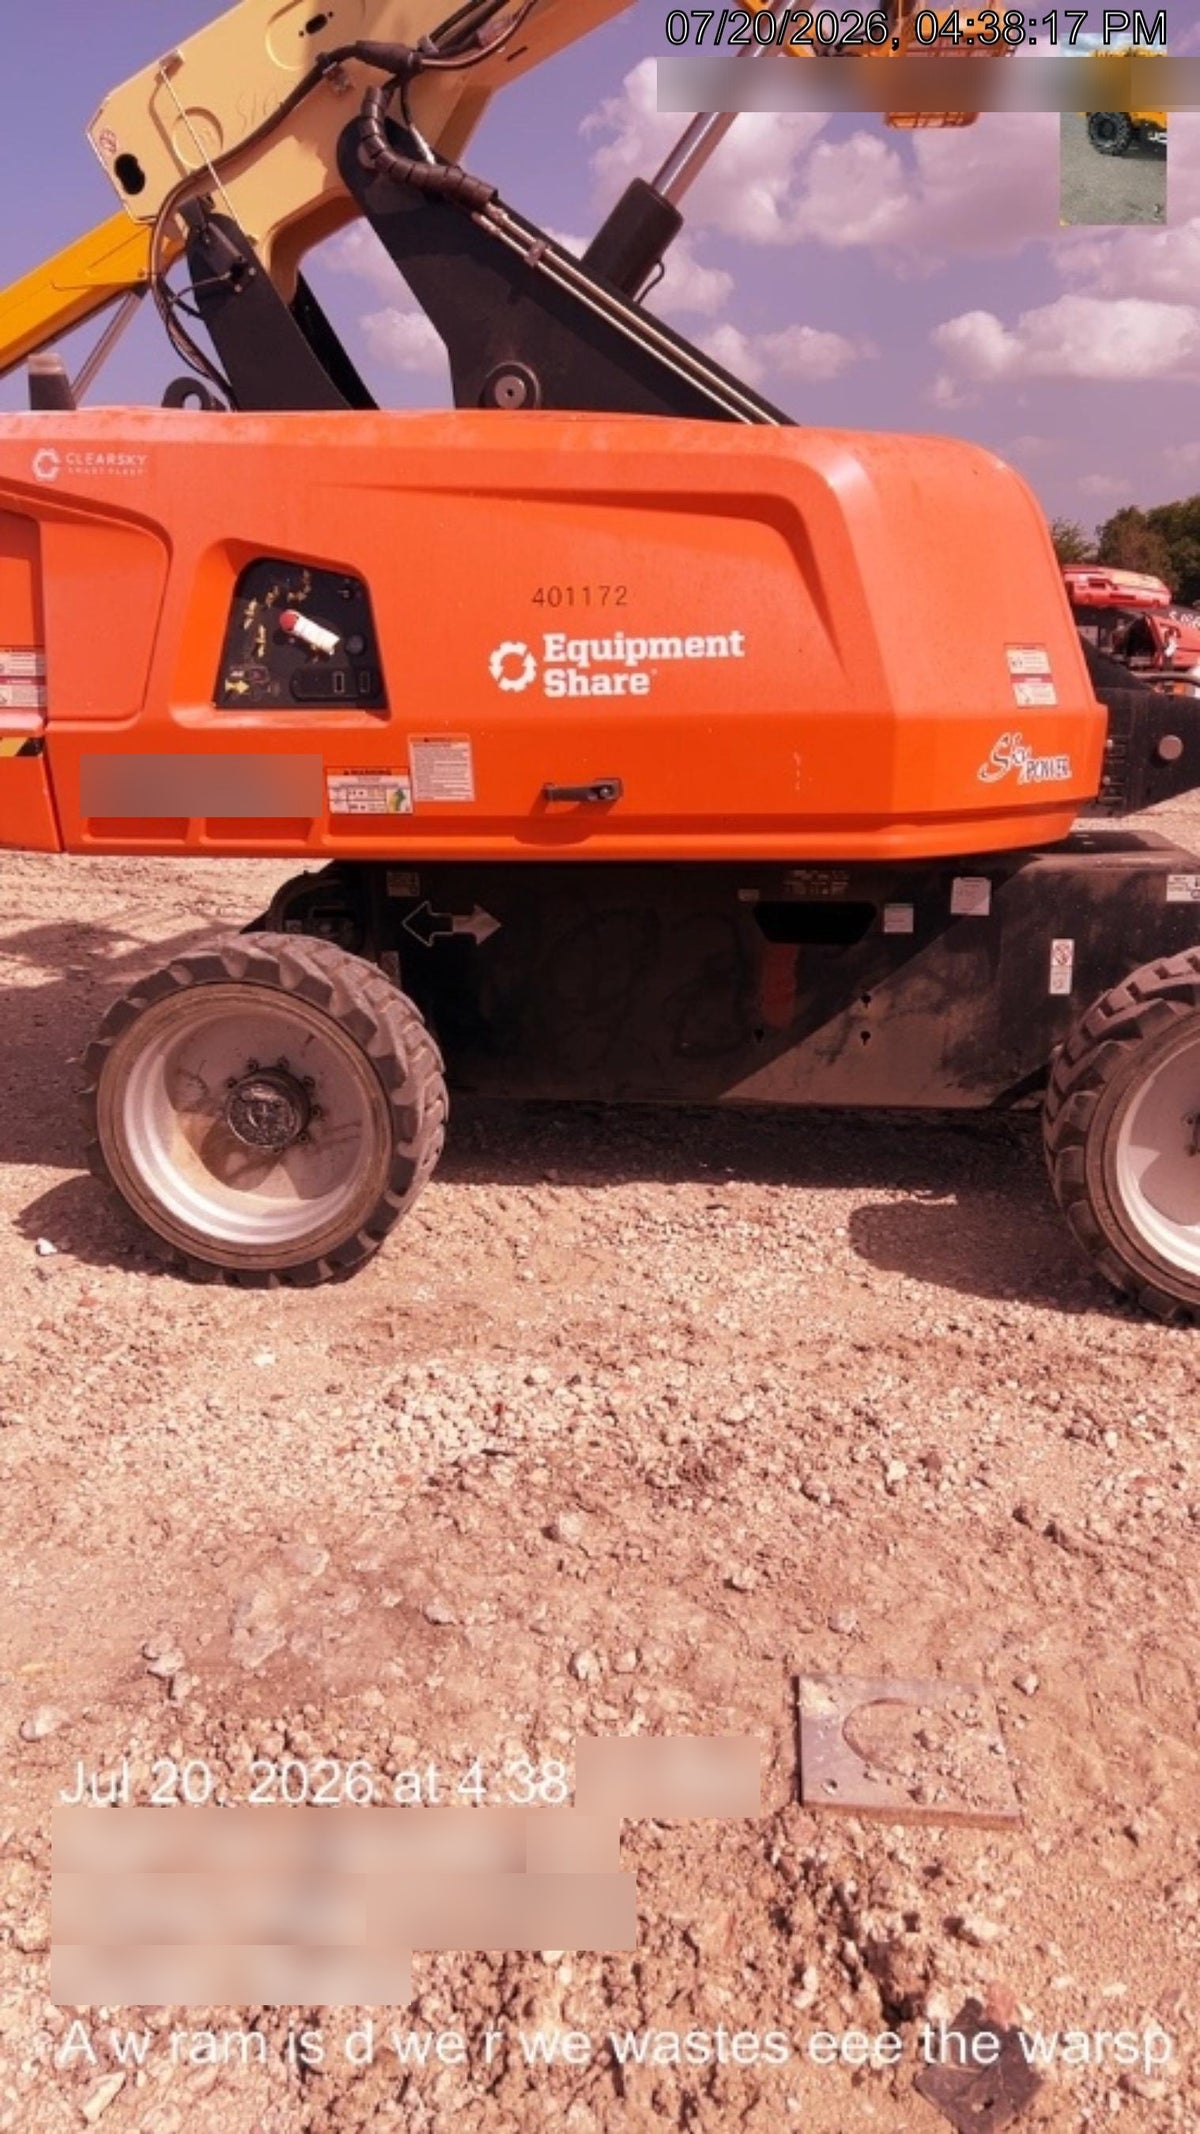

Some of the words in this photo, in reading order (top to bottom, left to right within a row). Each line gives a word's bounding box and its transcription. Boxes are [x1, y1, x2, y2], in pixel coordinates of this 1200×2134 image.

[65, 452, 148, 466] CLEARSKY
[531, 585, 628, 608] 401172
[542, 630, 746, 668] Equipment
[543, 668, 651, 698] Share
